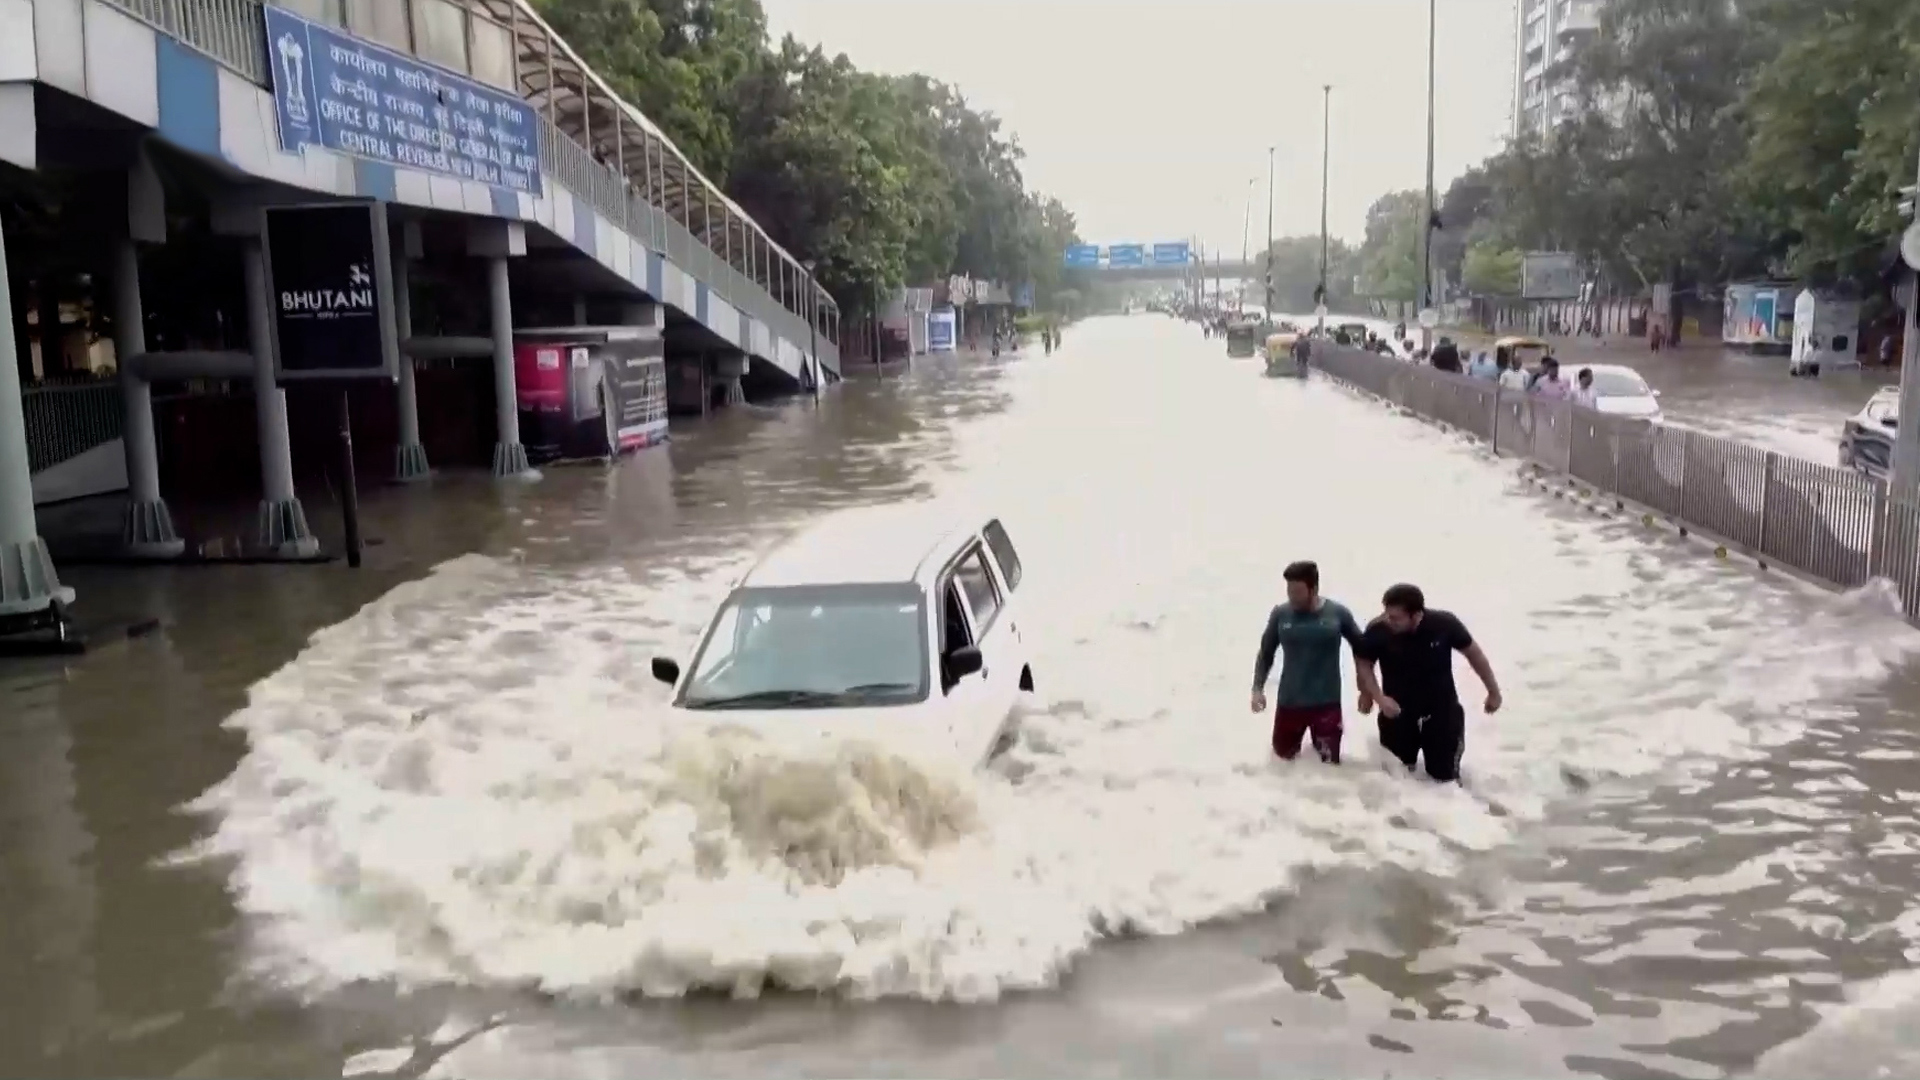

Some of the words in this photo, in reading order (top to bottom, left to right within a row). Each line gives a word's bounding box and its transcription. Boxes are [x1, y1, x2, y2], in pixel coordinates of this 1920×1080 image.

[321, 99, 363, 128] OFFICE
[366, 112, 381, 132] OF
[385, 116, 407, 138] THE
[340, 129, 393, 159] CENTRAL
[282, 290, 373, 310] BHUTANI
